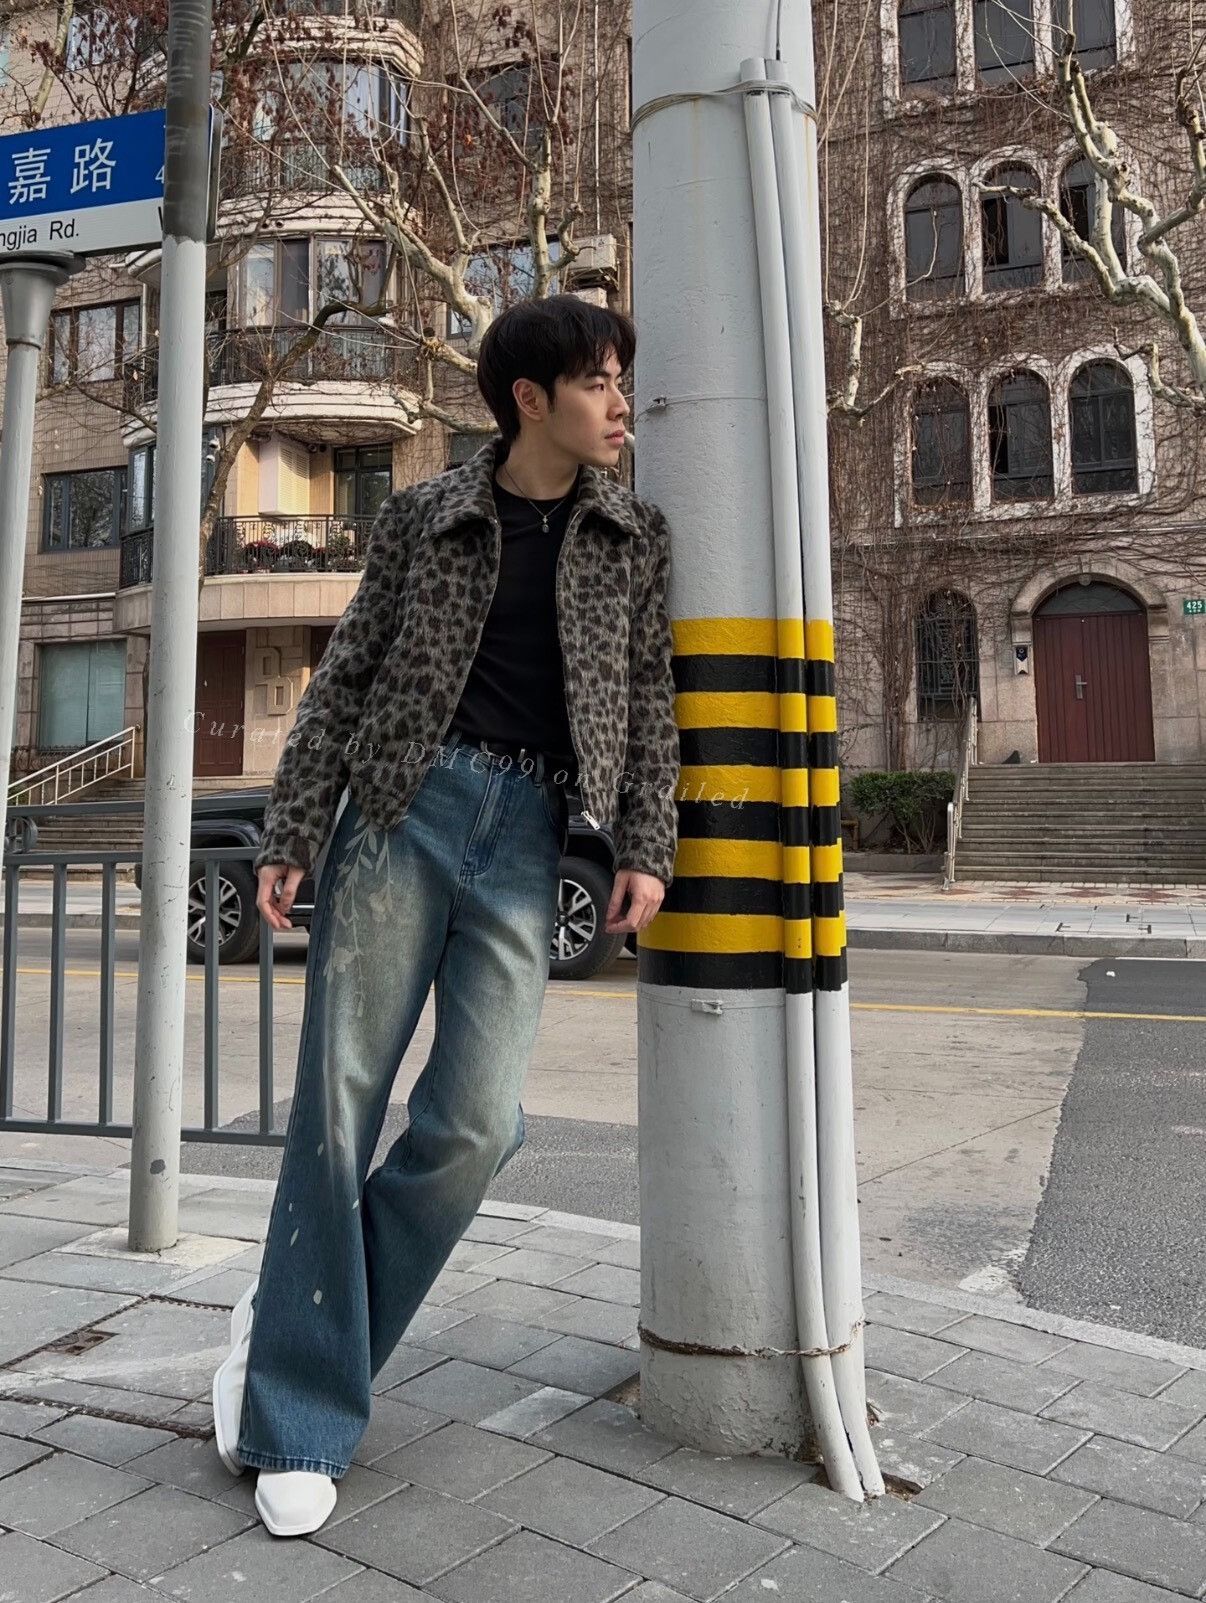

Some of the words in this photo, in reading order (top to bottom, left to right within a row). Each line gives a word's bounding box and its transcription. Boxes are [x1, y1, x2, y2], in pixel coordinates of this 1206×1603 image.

[8, 137, 117, 205] 嘉路
[49, 218, 79, 240] Rd.
[1186, 600, 1203, 610] 425
